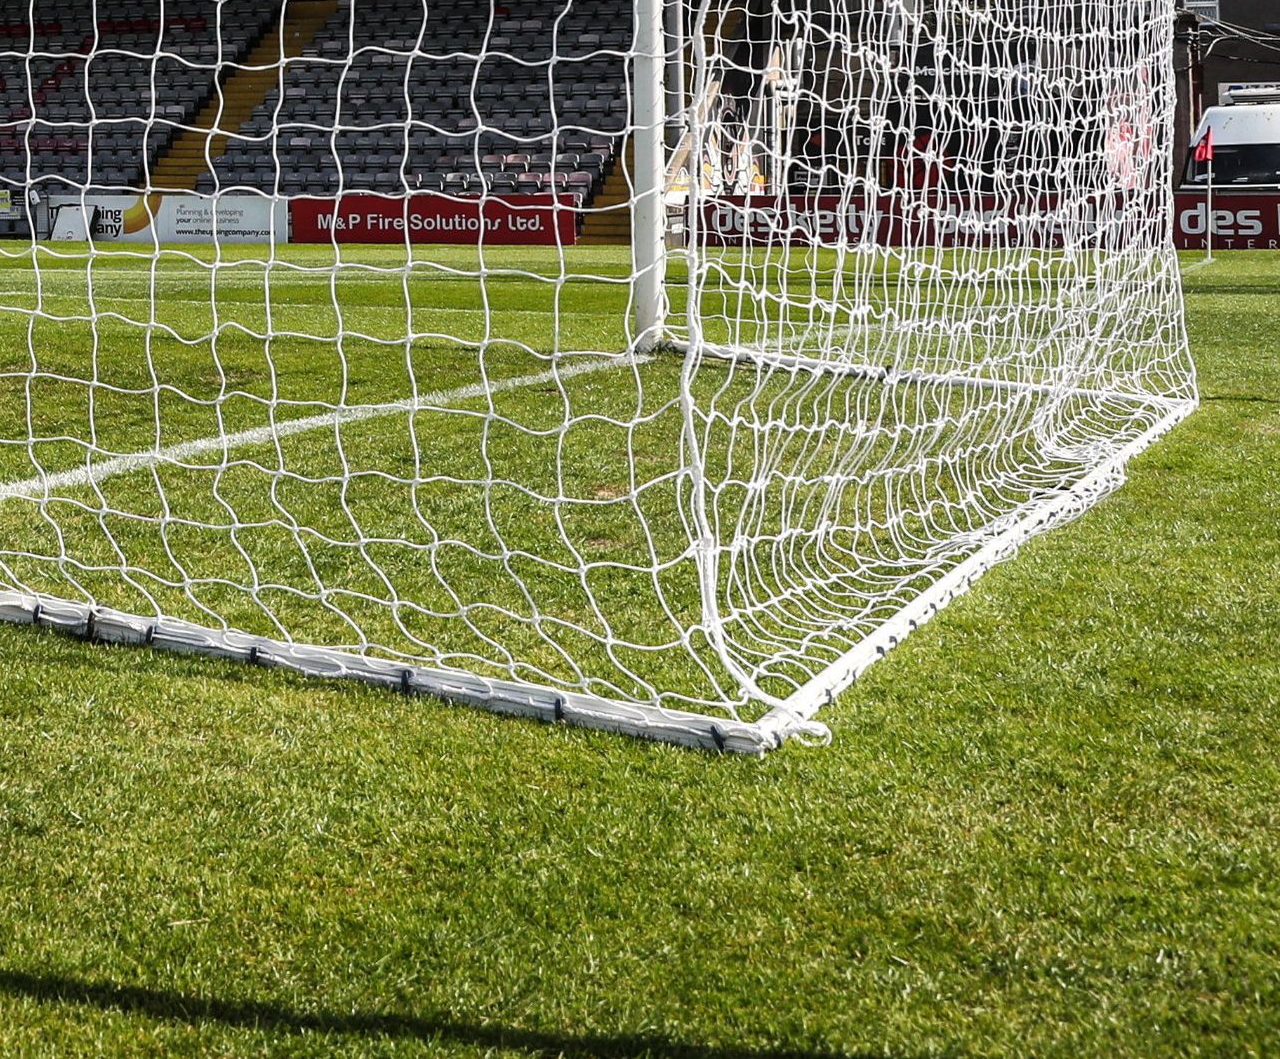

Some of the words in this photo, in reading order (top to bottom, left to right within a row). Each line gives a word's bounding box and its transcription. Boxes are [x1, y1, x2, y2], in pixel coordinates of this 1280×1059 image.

[176, 208, 203, 218] Planning
[214, 216, 240, 224] usiness
[1180, 202, 1263, 236] des
[317, 214, 361, 231] M&P
[367, 213, 404, 231] Fire
[410, 213, 502, 231] Solutions
[508, 213, 545, 231] Ltd.
